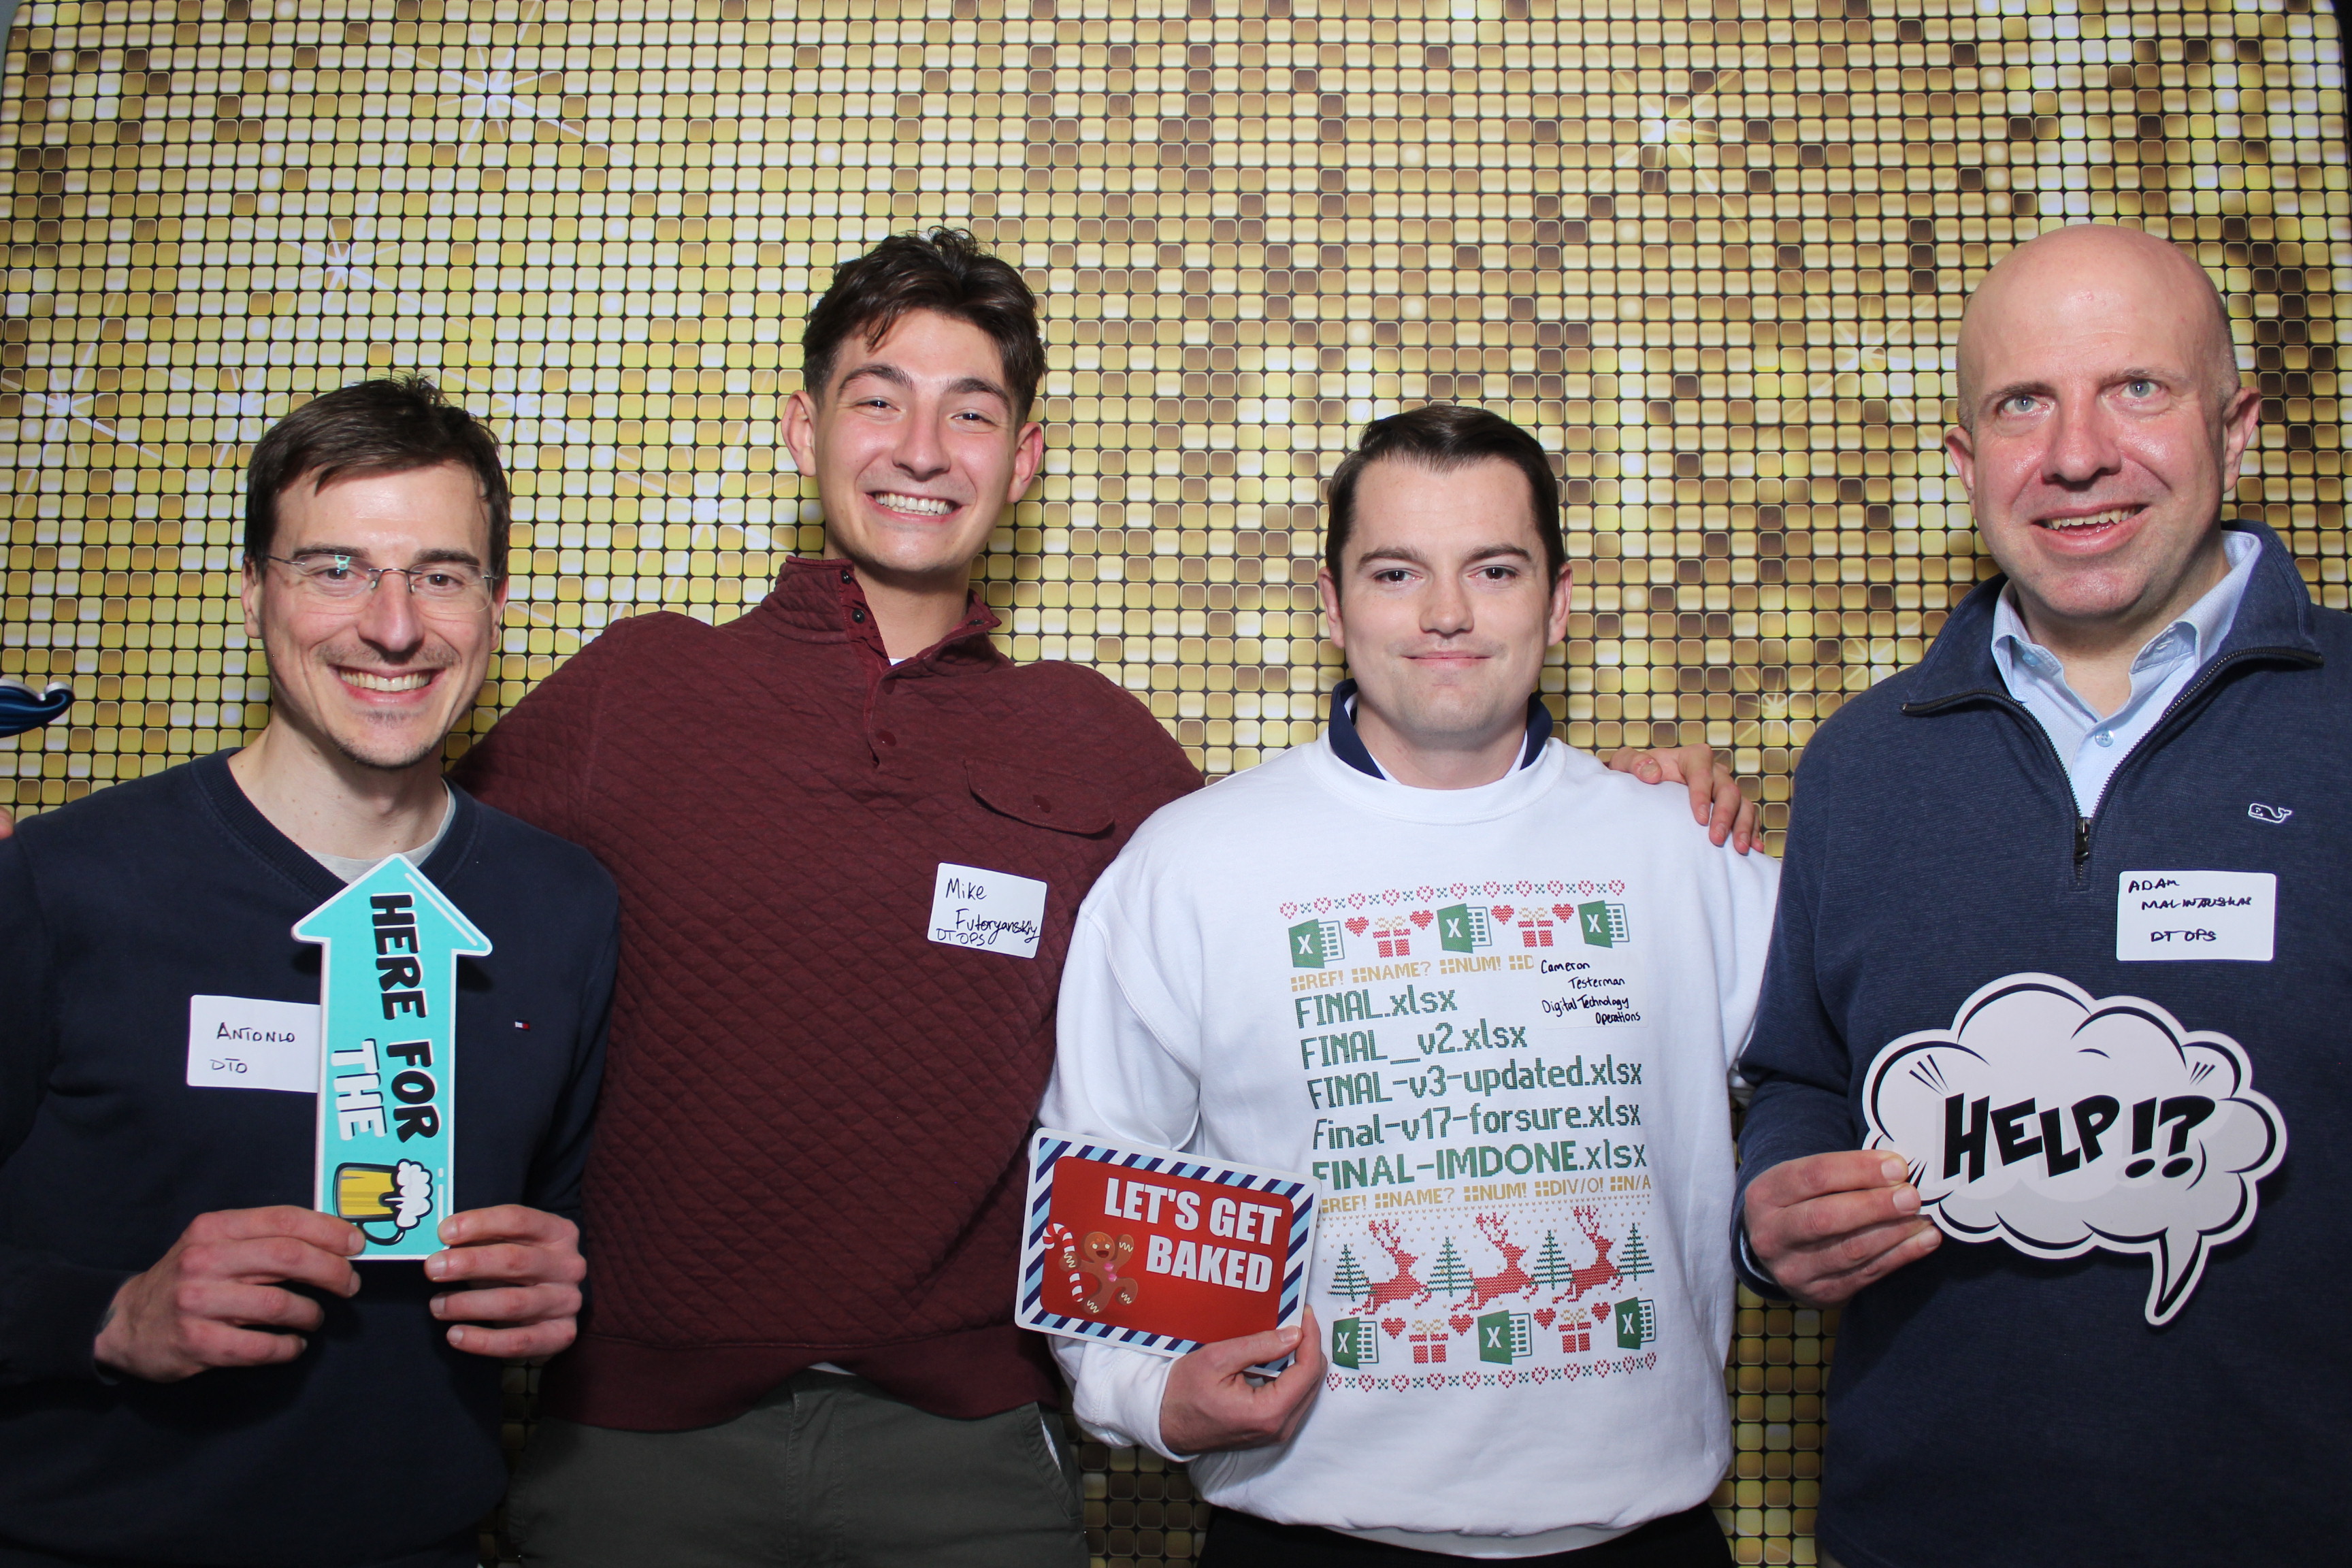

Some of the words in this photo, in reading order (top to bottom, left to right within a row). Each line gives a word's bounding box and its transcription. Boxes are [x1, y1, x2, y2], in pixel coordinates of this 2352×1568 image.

[945, 877, 987, 900] Mike
[370, 892, 429, 1020] HERE
[1541, 959, 1590, 974] Cameron
[1567, 976, 1625, 990] Testerman
[1294, 984, 1458, 1029] FINAL.xlsx
[1541, 996, 1578, 1017] Digital
[1577, 994, 1630, 1011] Technology
[1595, 1011, 1641, 1026] Operations
[216, 1022, 295, 1043] ANTONIO
[210, 1058, 248, 1073] DTO
[1307, 1054, 1642, 1109] FINAL-v3-updated.xlsx
[331, 1038, 388, 1141] THE
[386, 1039, 442, 1143] FOR
[1104, 1177, 1200, 1231] LET'S
[1209, 1197, 1283, 1245] GET
[1145, 1234, 1273, 1293] BAKED
